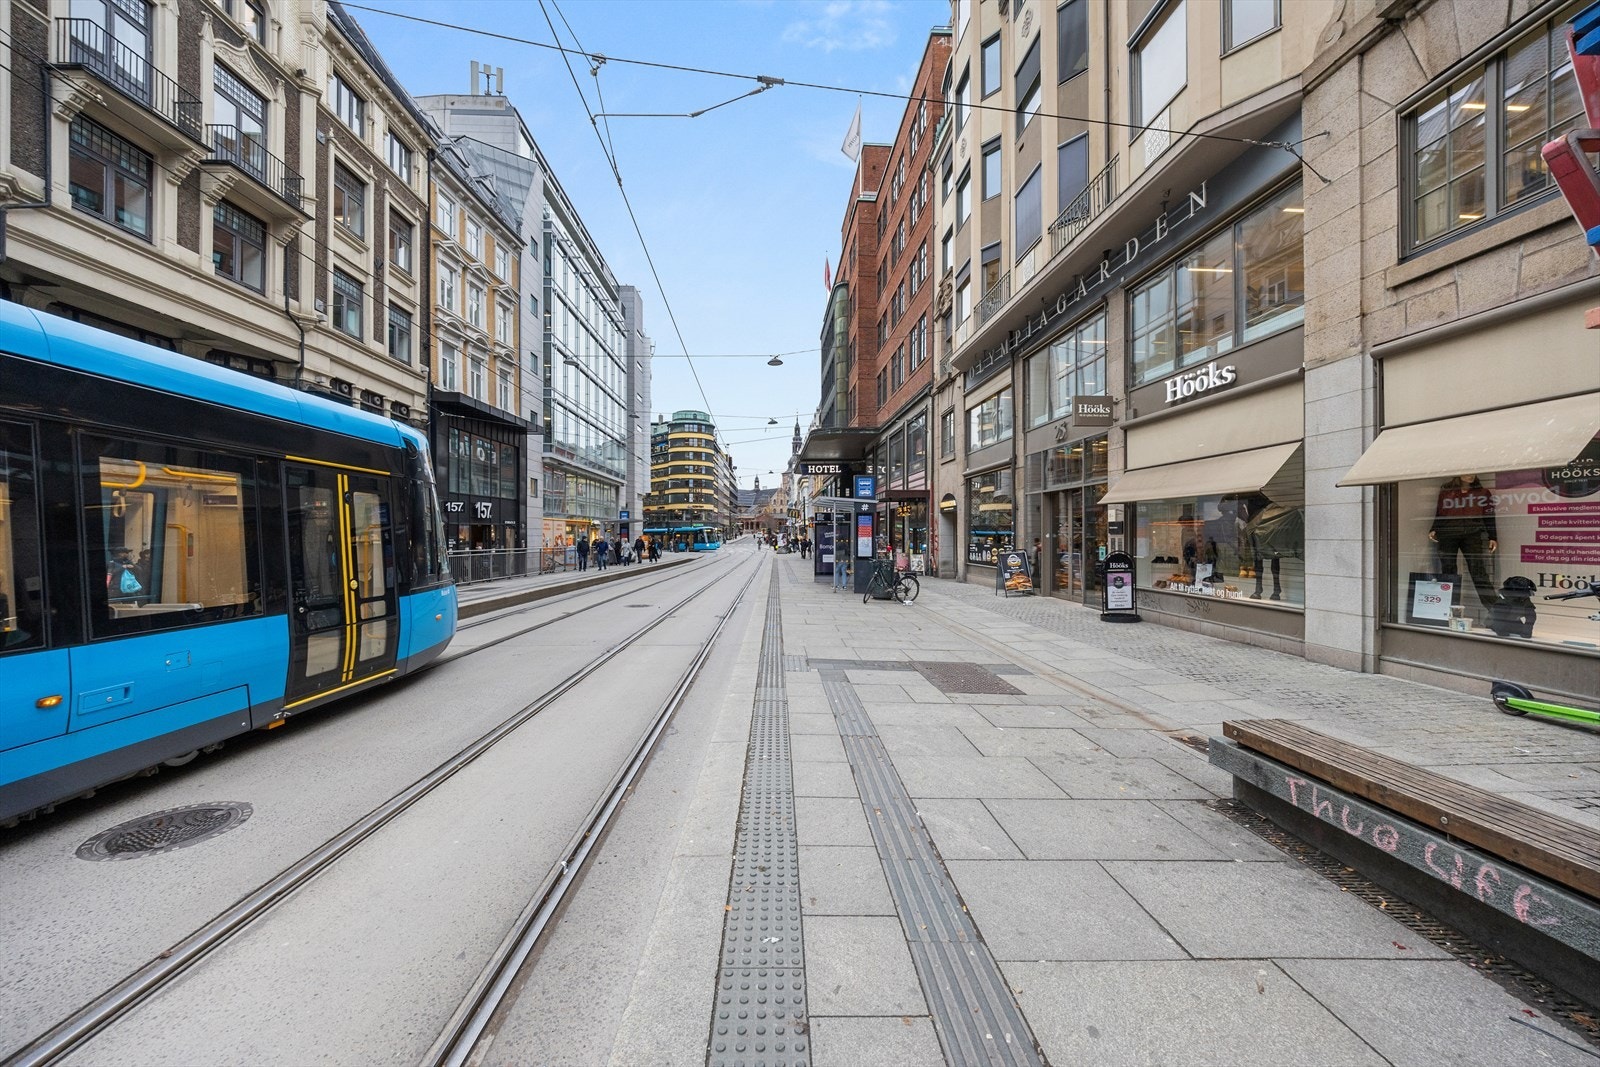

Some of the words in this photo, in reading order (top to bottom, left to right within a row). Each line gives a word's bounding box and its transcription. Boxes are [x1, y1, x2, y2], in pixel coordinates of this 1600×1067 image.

[1165, 362, 1236, 403] Hööks
[1078, 403, 1111, 414] Hööks
[808, 465, 842, 473] HOTEL
[1551, 467, 1600, 479] HÖÖKS
[1216, 590, 1225, 598] og
[1225, 589, 1243, 598] hund
